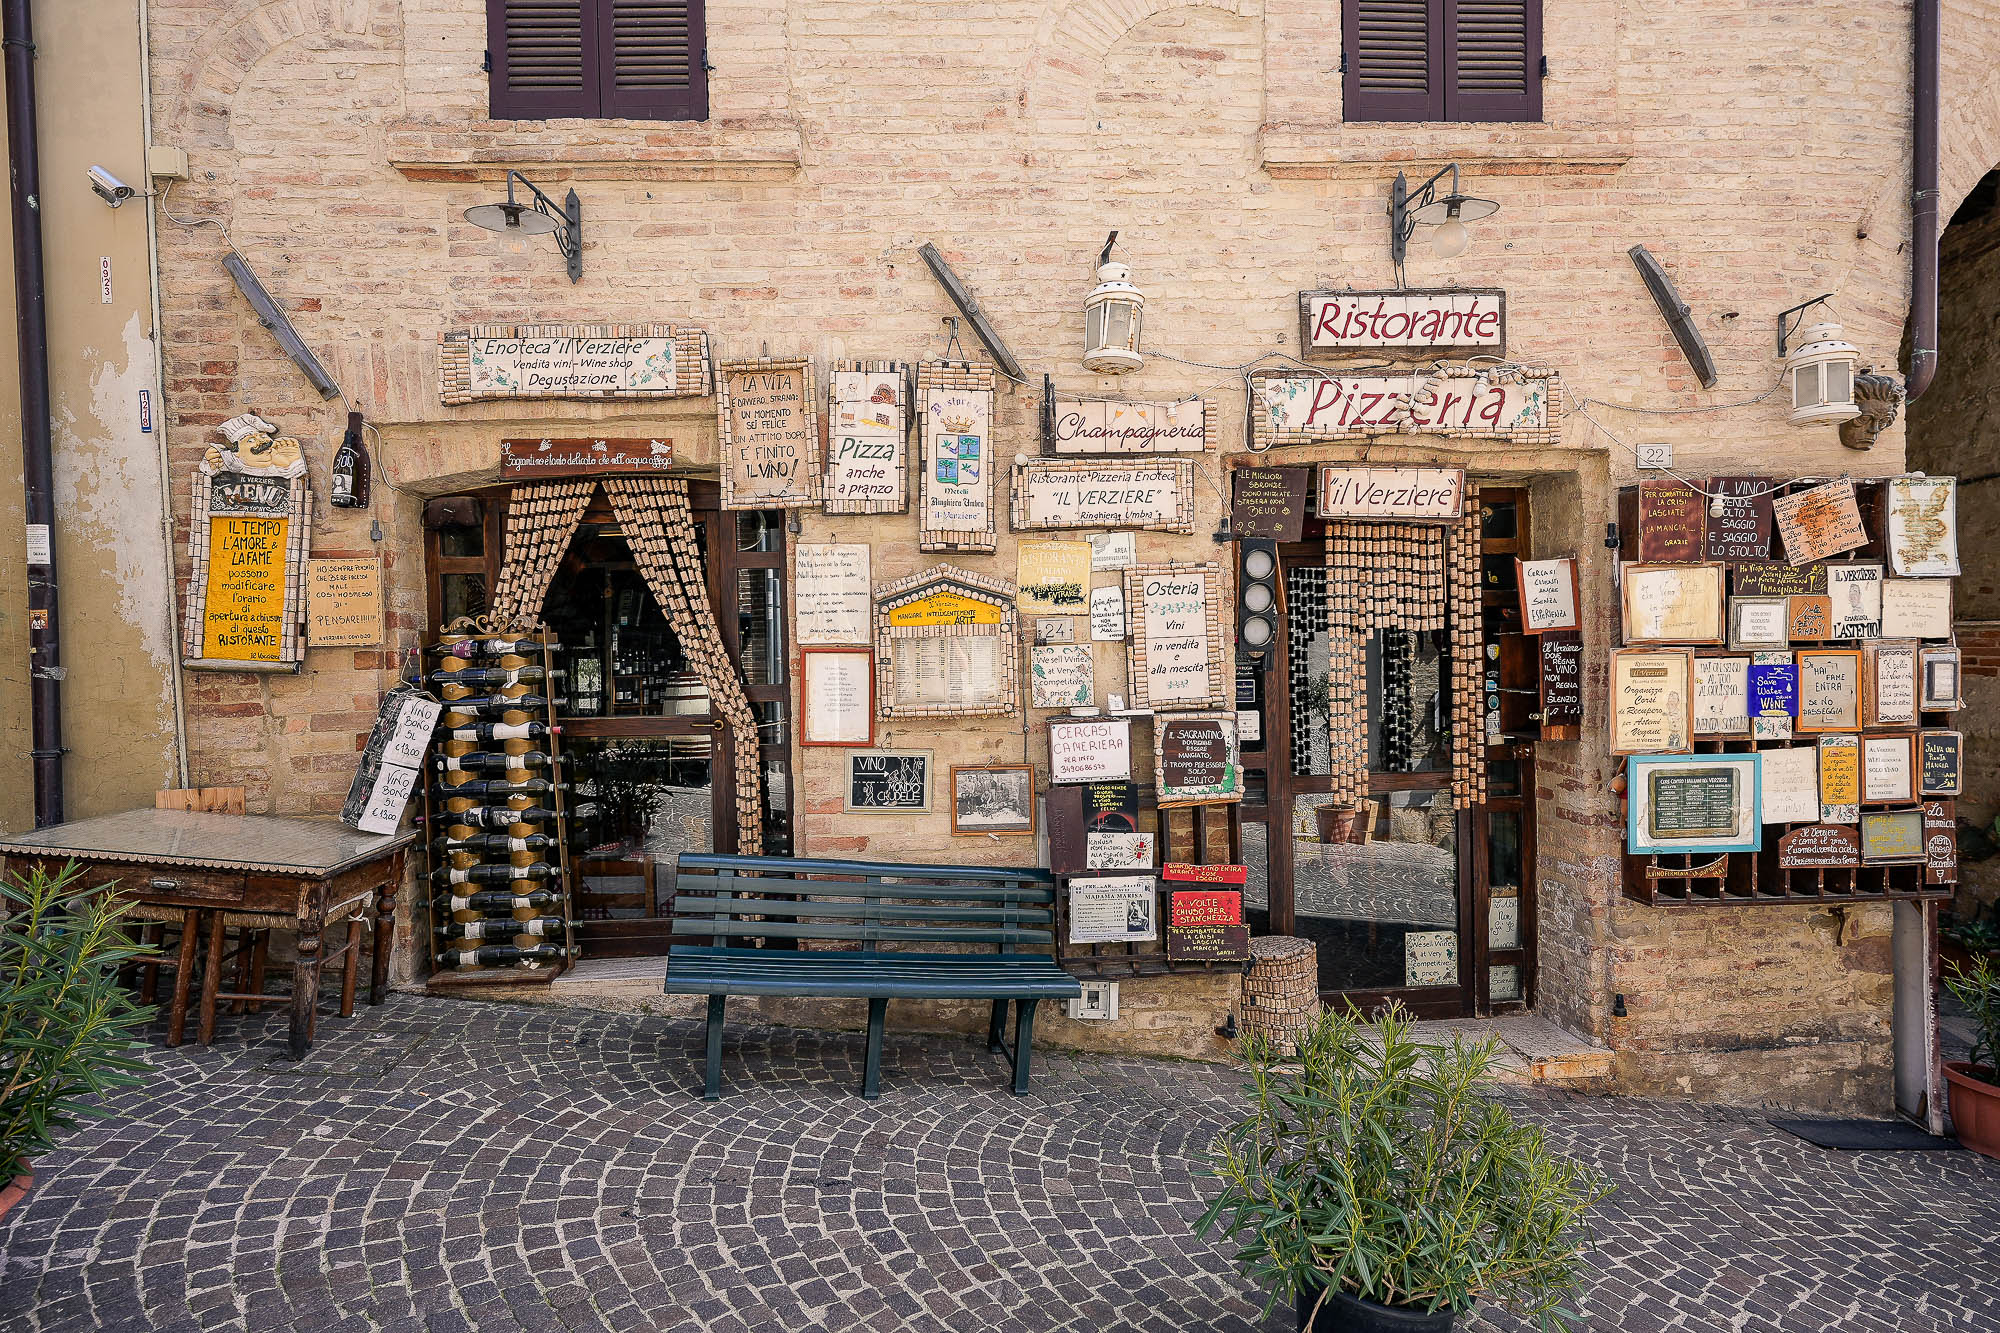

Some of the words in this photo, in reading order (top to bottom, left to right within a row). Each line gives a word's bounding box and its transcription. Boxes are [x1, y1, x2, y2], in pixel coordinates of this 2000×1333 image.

[1313, 301, 1499, 340] Ristorante
[485, 340, 550, 354] Enoteca
[513, 359, 550, 369] Vendita
[609, 358, 632, 369] shop
[529, 374, 617, 389] Degustazione
[743, 376, 756, 392] LA
[762, 374, 792, 390] VITA
[1306, 380, 1506, 425] Pizzeria
[741, 410, 750, 419] UN
[755, 409, 791, 418] MOMENTO
[747, 420, 757, 429] SEI
[762, 418, 786, 428] FELICE
[1057, 413, 1203, 448] Champagneria
[749, 432, 782, 442] ATTIMO
[785, 431, 805, 439] DOPO
[756, 444, 794, 459] FINITO
[839, 438, 894, 462] Pizza
[1647, 449, 1664, 462] 22
[549, 454, 566, 465] tanto
[567, 452, 595, 465] delicato
[599, 454, 609, 465] che
[649, 455, 672, 469] affoga
[746, 464, 758, 478] IL
[846, 466, 885, 479] anche
[1251, 472, 1282, 480] MIGLIORI
[1030, 473, 1086, 484] Ristorante
[1090, 472, 1131, 482] Pizzeria
[1134, 471, 1175, 481] Enoteca
[838, 485, 845, 494] a
[848, 483, 893, 497] pranzo
[1718, 481, 1729, 494] IL
[1735, 481, 1767, 494] VINO
[1237, 498, 1268, 506] STASERA
[1649, 509, 1685, 517] LASCIATE
[229, 521, 240, 534] IL
[242, 521, 280, 536] TEMPO
[1721, 519, 1756, 529] SAGGIO
[1709, 532, 1716, 541] E
[1722, 533, 1757, 542] SAGGIO
[223, 536, 267, 550] L'AMORE
[1712, 546, 1724, 555] LO
[233, 551, 244, 565] LA
[247, 551, 272, 565] FAME
[229, 570, 268, 580] possono
[222, 580, 275, 591] modificare
[1147, 581, 1198, 596] Osteria
[233, 592, 266, 603] l'orario
[242, 604, 250, 612] di
[209, 610, 248, 623] apertura
[954, 616, 975, 624] ARTE
[231, 623, 238, 632] di
[243, 623, 268, 636] questo
[1046, 623, 1065, 638] 24
[1166, 620, 1184, 630] Vini
[218, 634, 276, 646] RISTORANTE
[1154, 643, 1162, 651] in
[1166, 639, 1199, 650] vendita
[1057, 668, 1074, 676] Very
[1151, 664, 1166, 674] alla
[1170, 663, 1203, 673] mescita
[1556, 665, 1577, 674] VINO
[1814, 667, 1826, 675] HAI
[1039, 678, 1082, 687] competitive
[1757, 676, 1776, 686] Save
[1624, 686, 1663, 696] Organizza
[1757, 687, 1782, 695] Water
[1816, 683, 1842, 692] ENTRA
[1634, 695, 1657, 705] Corsi
[1760, 697, 1787, 709] WINE
[410, 700, 432, 719] VINO
[1627, 707, 1663, 716] Recupero
[1803, 707, 1843, 716] PASSEGGIA
[404, 716, 430, 731] BONO
[405, 731, 416, 741] 5L
[1058, 725, 1111, 739] CERCASI
[1177, 730, 1223, 739] SAGRANTINO
[1054, 739, 1123, 754] CAMERIERA
[1925, 742, 1944, 753] SALVA
[858, 757, 886, 770] VINO
[386, 770, 409, 787] VINO
[1184, 776, 1215, 784] BEVUTO
[381, 786, 408, 799] BONO
[889, 783, 920, 792] MONDO
[384, 799, 396, 808] 5L
[1190, 899, 1218, 907] VOLTE
[1180, 915, 1234, 923] STANCHEZZA
